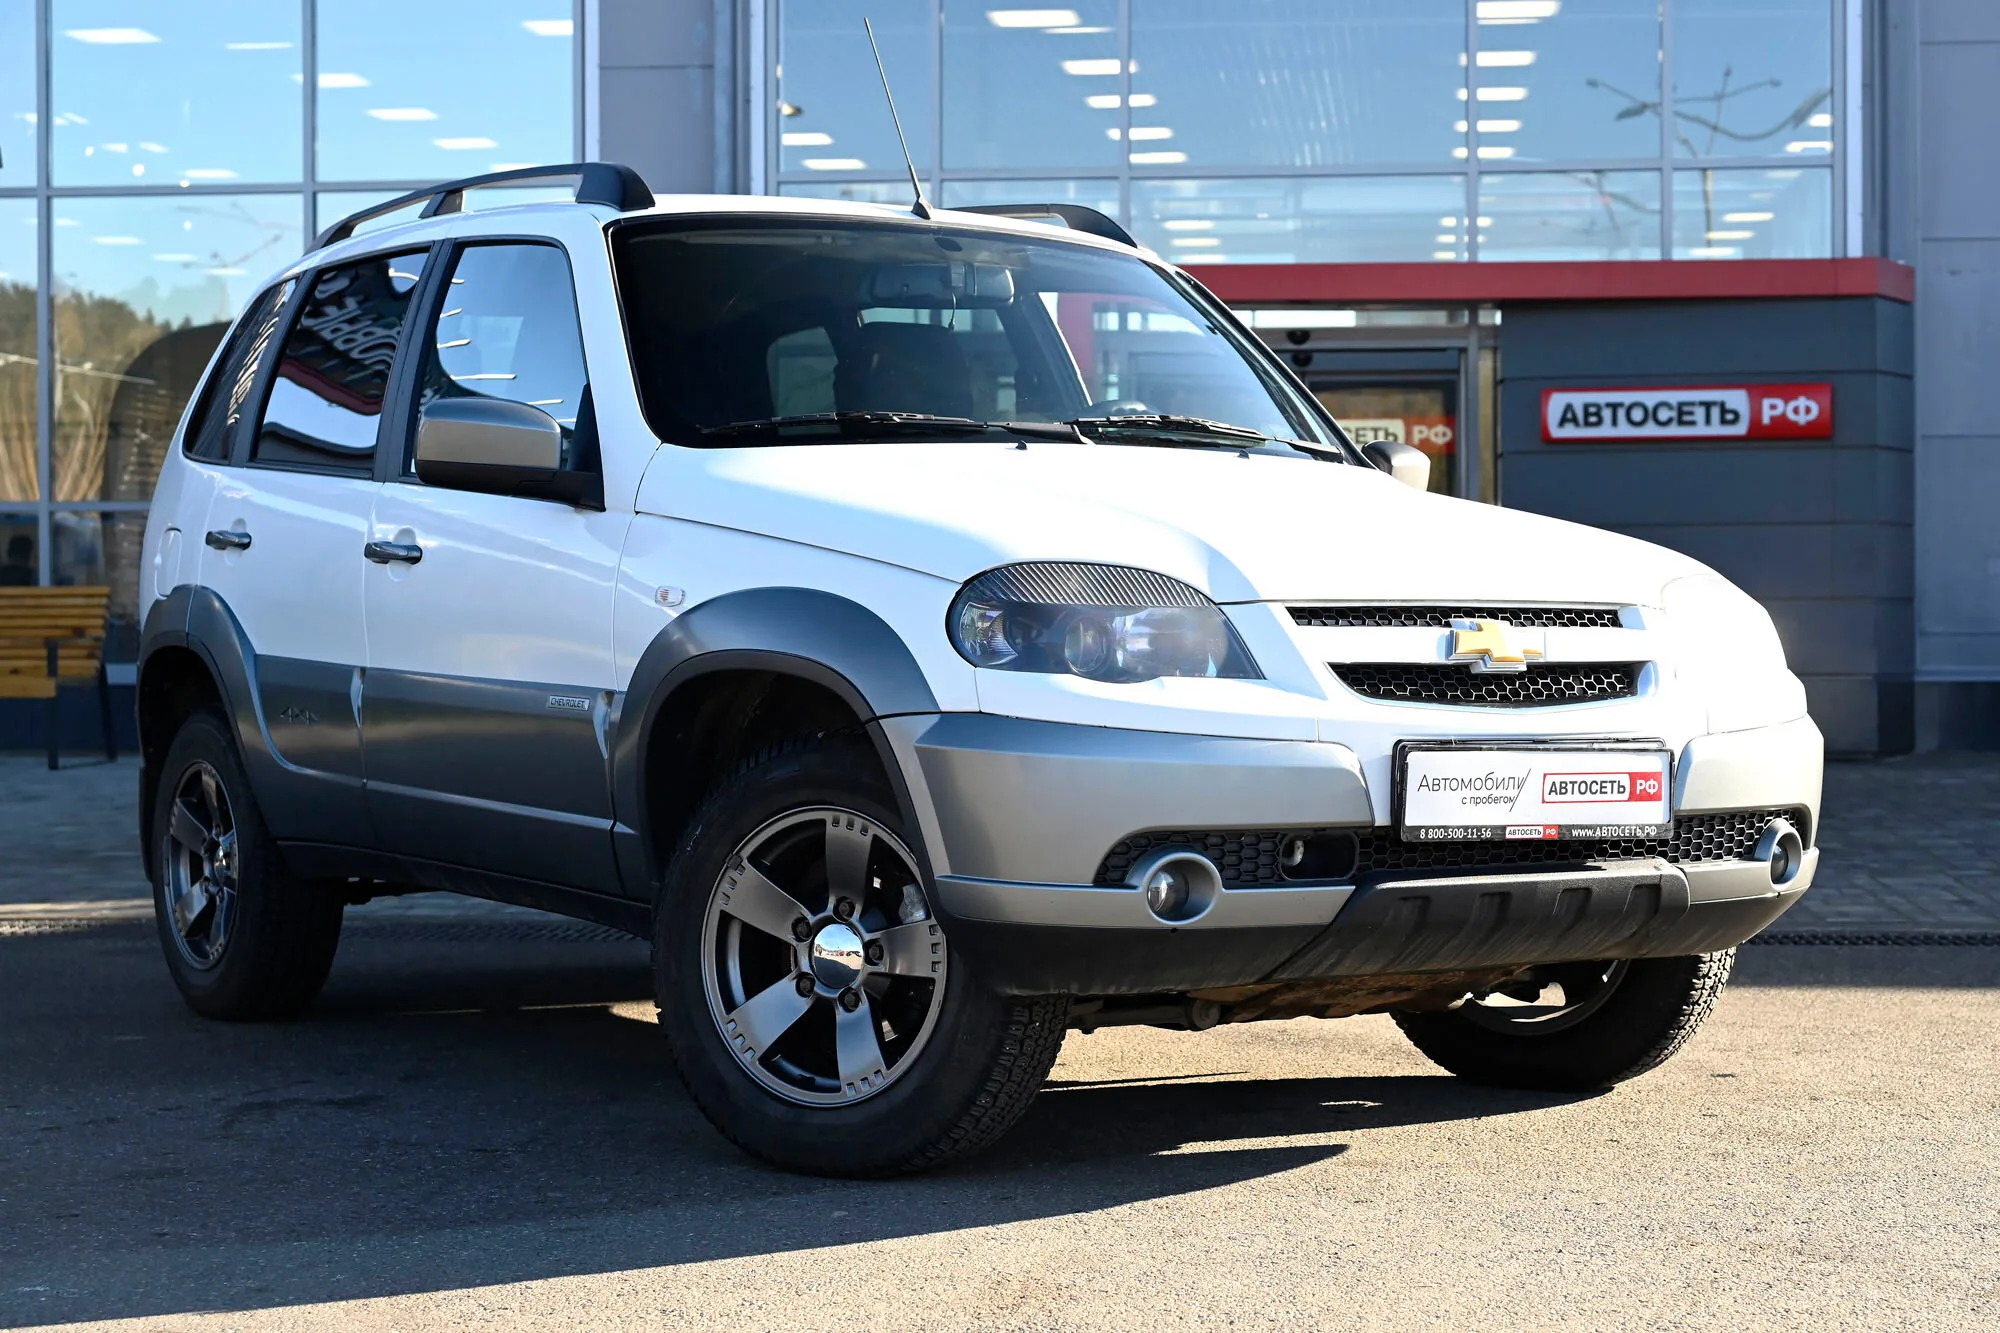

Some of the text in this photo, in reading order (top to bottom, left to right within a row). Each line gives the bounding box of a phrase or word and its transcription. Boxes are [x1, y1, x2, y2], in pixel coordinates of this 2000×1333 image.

[1557, 395, 1820, 428] АВТОСЕТЬ РФ
[1412, 424, 1454, 446] РФ
[550, 697, 586, 709] CHEVROLET
[1548, 778, 1659, 796] АВТОСЕТЬ РФ
[1461, 793, 1516, 807] с пробегом
[1420, 827, 1492, 839] 8 800-500-11-56
[1507, 827, 1557, 836] АВТОСЕТЬ РФ
[1571, 825, 1658, 837] www.АВТОСЕТЬ.РФ
